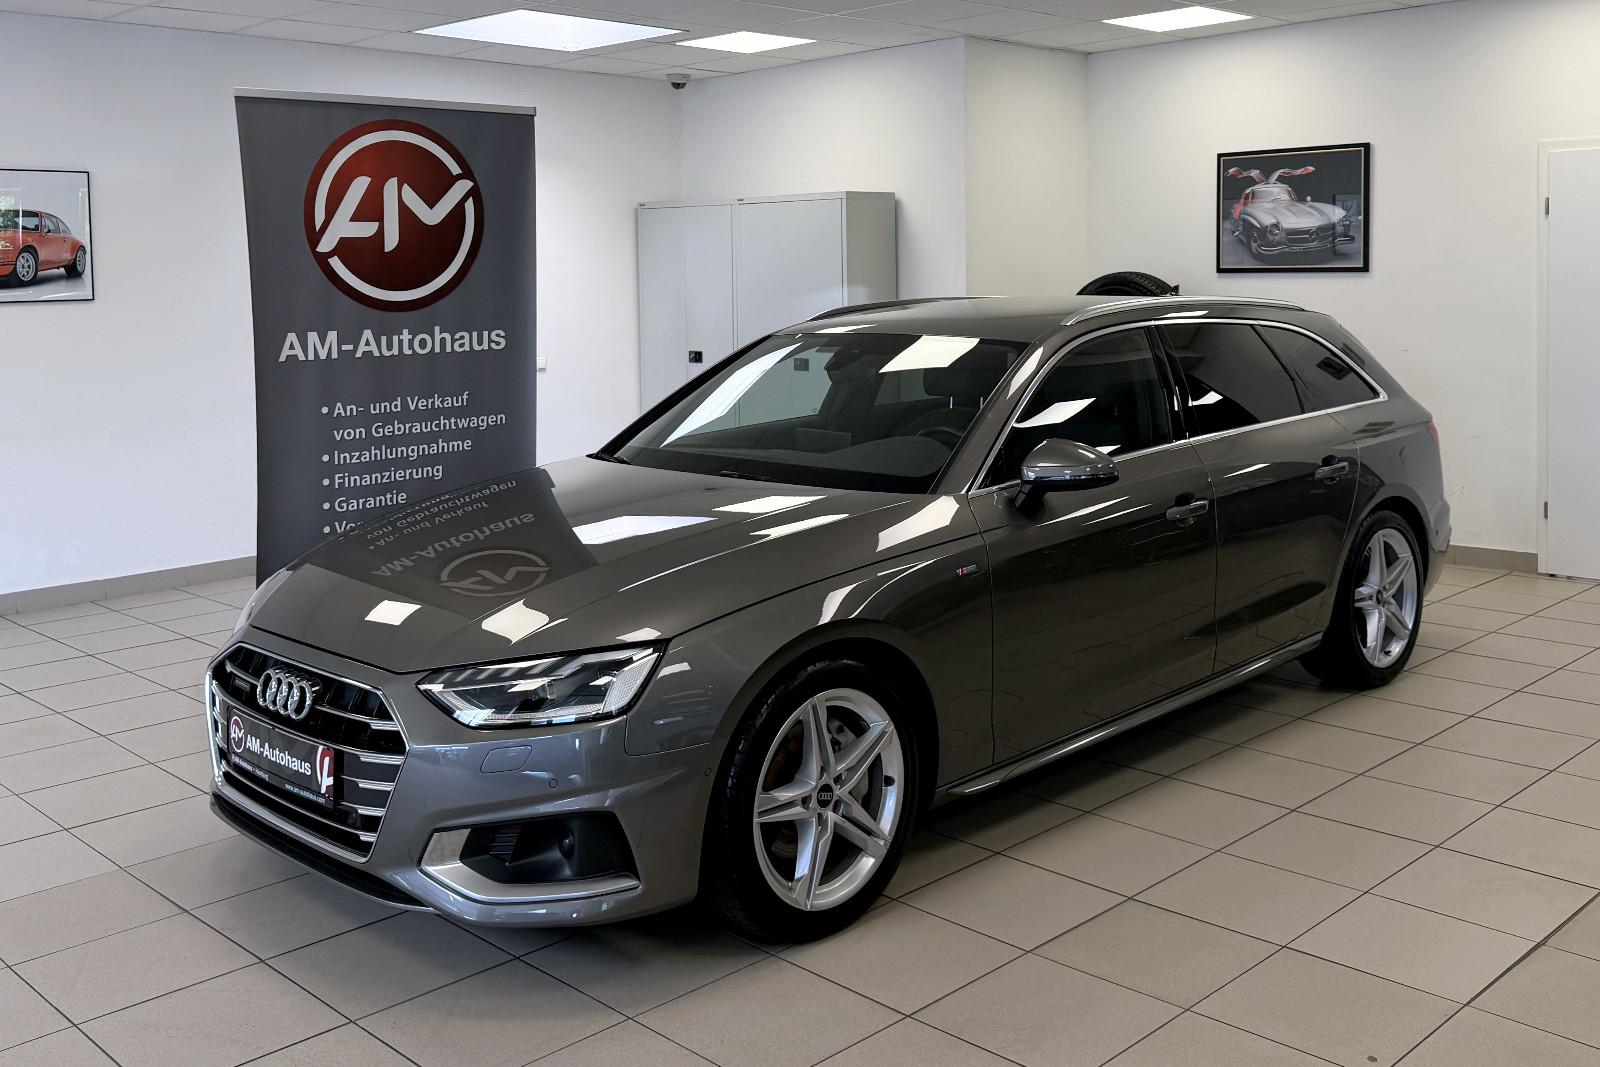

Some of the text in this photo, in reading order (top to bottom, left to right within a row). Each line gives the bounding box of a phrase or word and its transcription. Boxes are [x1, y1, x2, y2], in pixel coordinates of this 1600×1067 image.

[278, 325, 507, 362] AM-Autohaus
[333, 391, 470, 418] An- und Verkauf
[333, 412, 507, 441] von Gebrauchtwagen
[334, 438, 473, 465] Inzahlungnahme
[334, 463, 444, 489] Finanzierung
[334, 490, 408, 513] Garantie
[246, 734, 312, 776] AM-Autohaus
